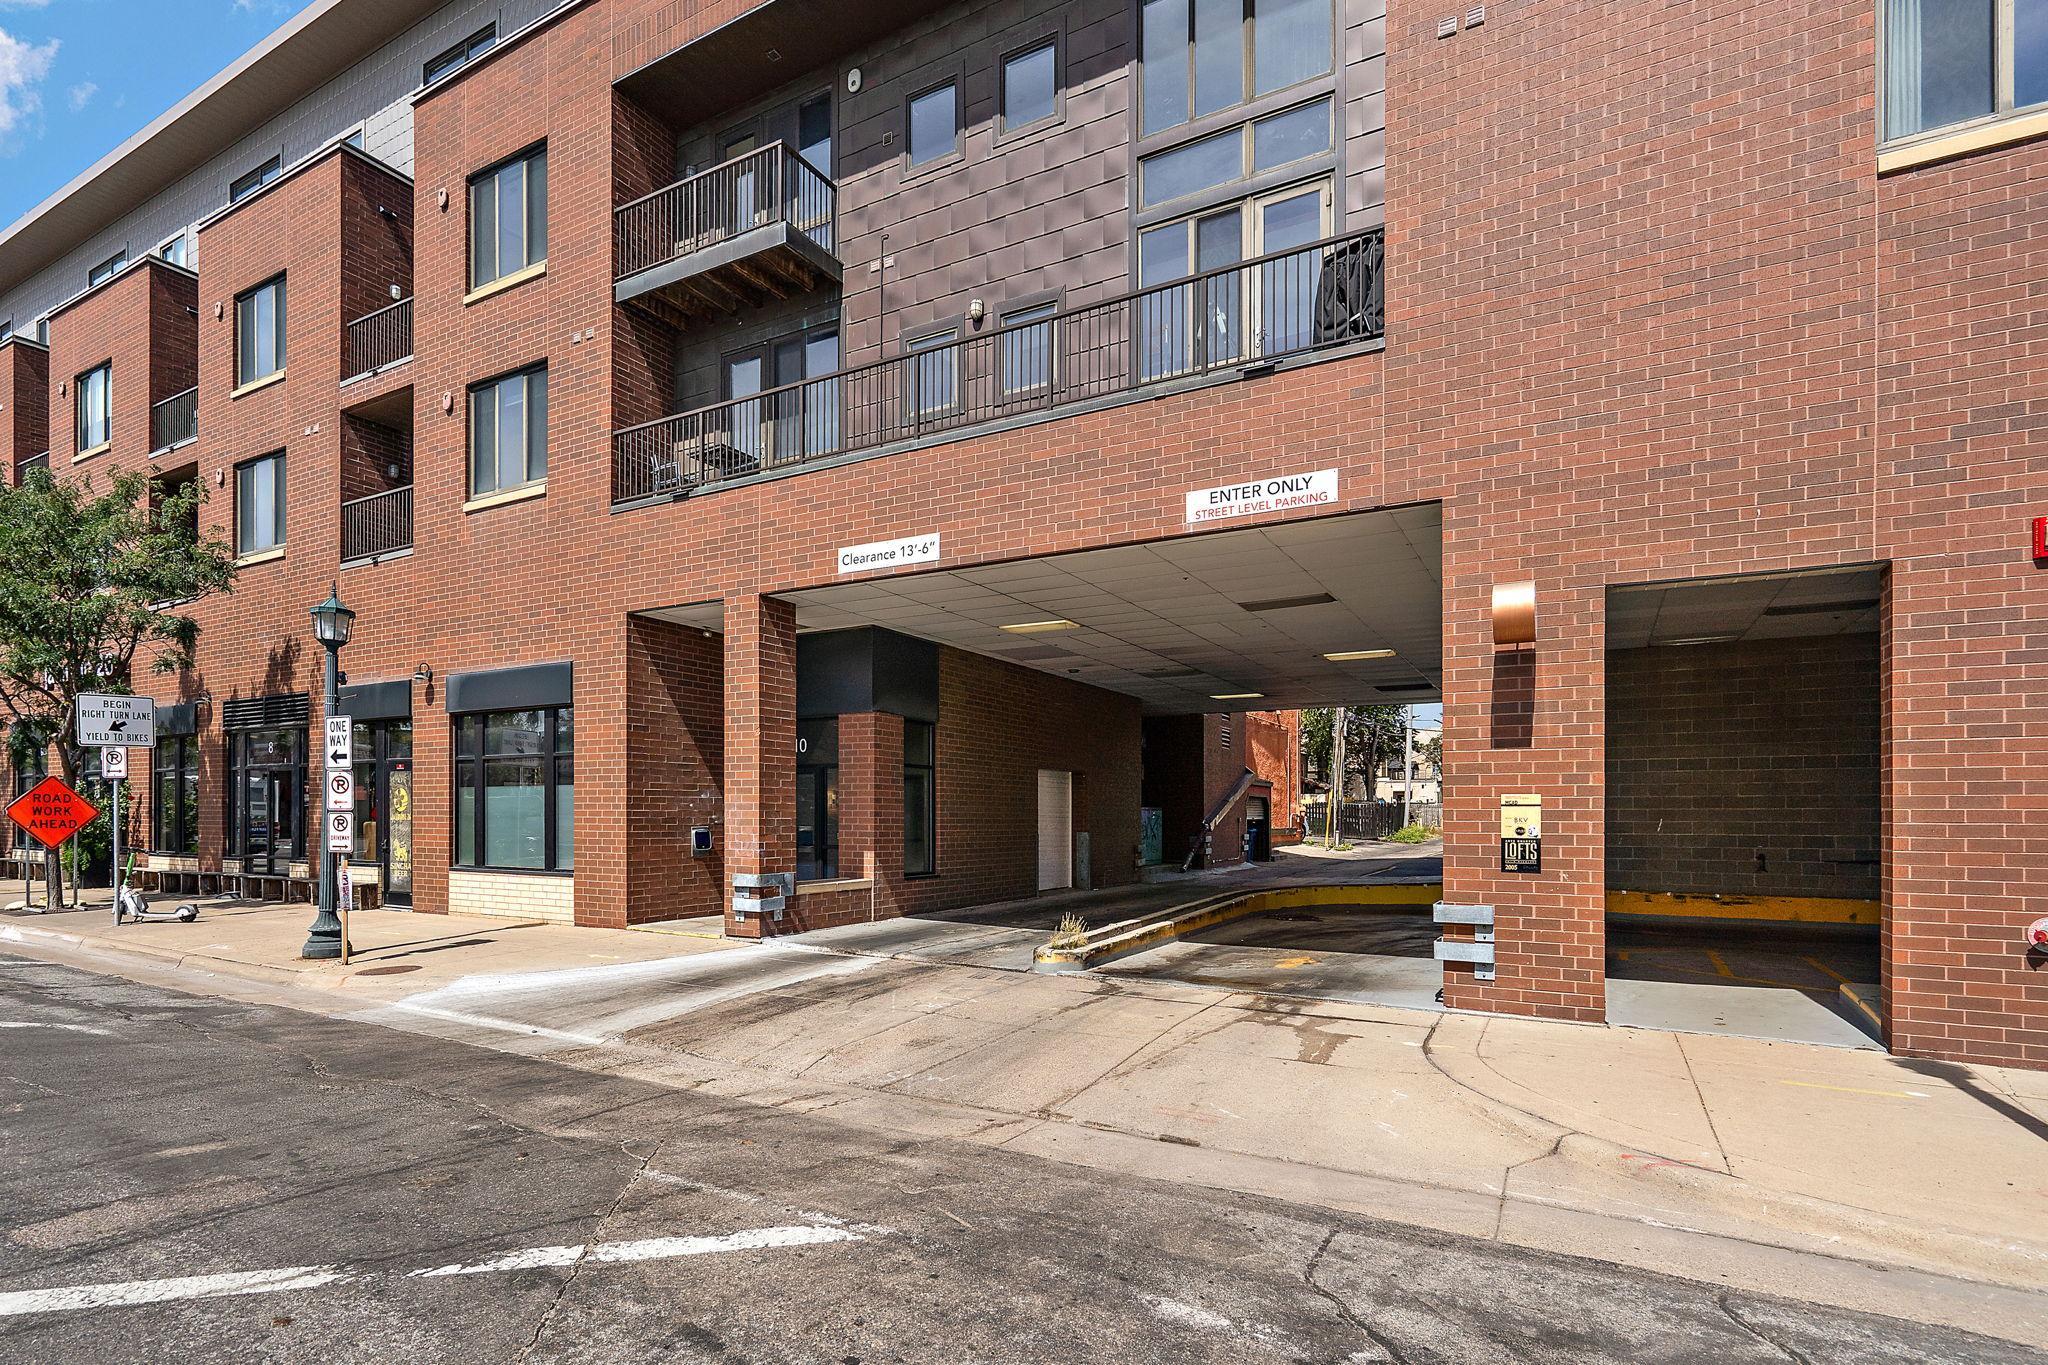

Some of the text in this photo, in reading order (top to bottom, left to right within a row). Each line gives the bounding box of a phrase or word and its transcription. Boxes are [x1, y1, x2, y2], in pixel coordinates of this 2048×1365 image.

[1210, 475, 1313, 504] ENTER ONLY
[1195, 491, 1328, 520] STREET LEVEL PARKING
[842, 550, 896, 566] Clearance
[103, 700, 131, 709] BEGIN
[82, 709, 152, 721] RIGHT TURN LANE
[330, 720, 347, 733] ONE
[86, 732, 149, 742] YIELD TO BIKES
[329, 734, 348, 747] WAY
[268, 741, 274, 754] 8
[33, 793, 72, 803] ROAD
[32, 806, 72, 816] WORK
[29, 819, 78, 829] AHEAD
[1504, 842, 1538, 860] LOFTS
